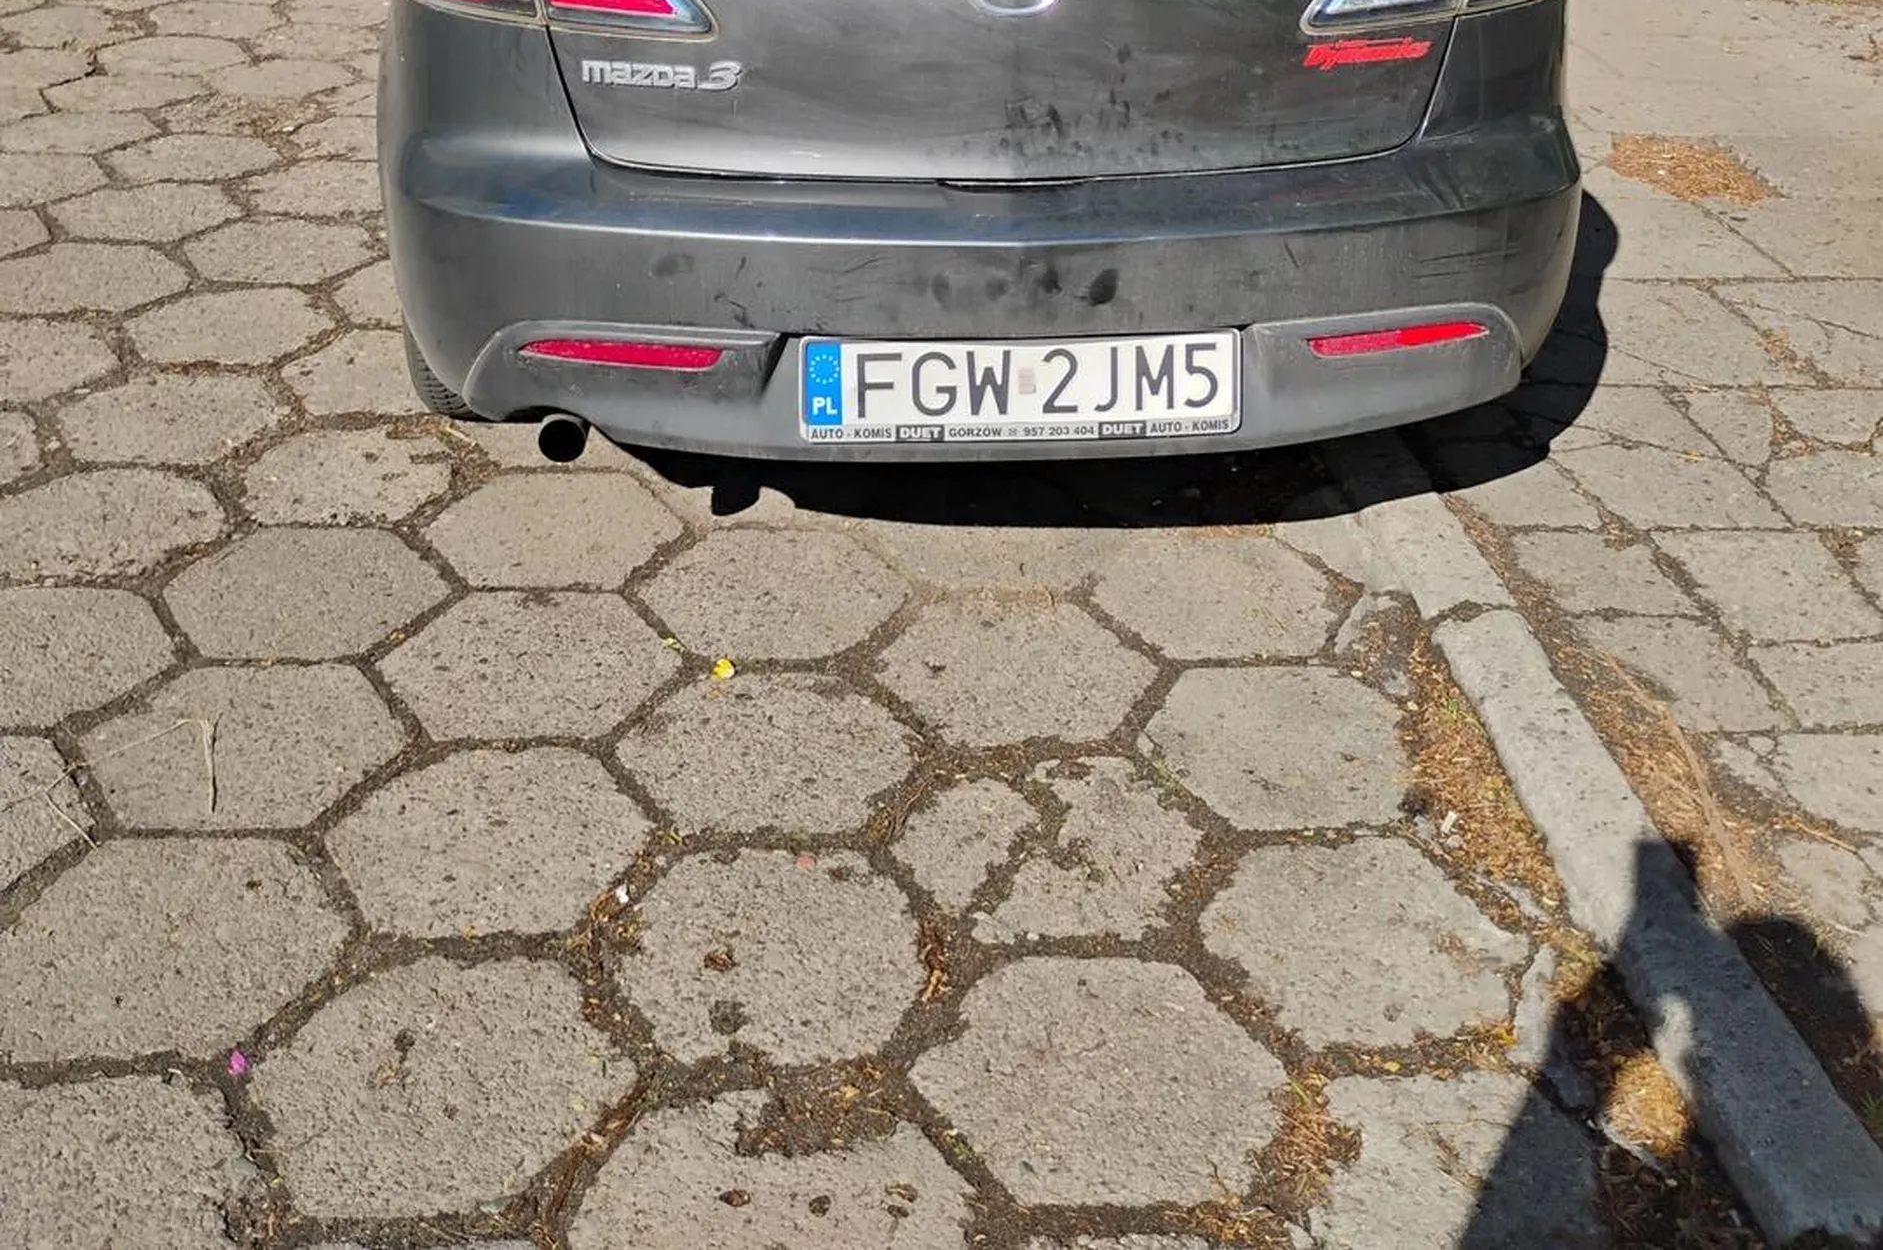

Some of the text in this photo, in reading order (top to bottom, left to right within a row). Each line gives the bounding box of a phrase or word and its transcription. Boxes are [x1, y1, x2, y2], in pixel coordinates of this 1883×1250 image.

[698, 60, 742, 92] 3
[856, 343, 1219, 419] FGW 2JM5
[812, 396, 839, 416] PL
[811, 428, 843, 440] AUTO
[854, 427, 892, 439] KOMIS
[900, 426, 941, 439] DUET
[1102, 423, 1144, 436] DUET
[1150, 422, 1181, 434] AUTO
[1191, 419, 1229, 432] KOMIS
